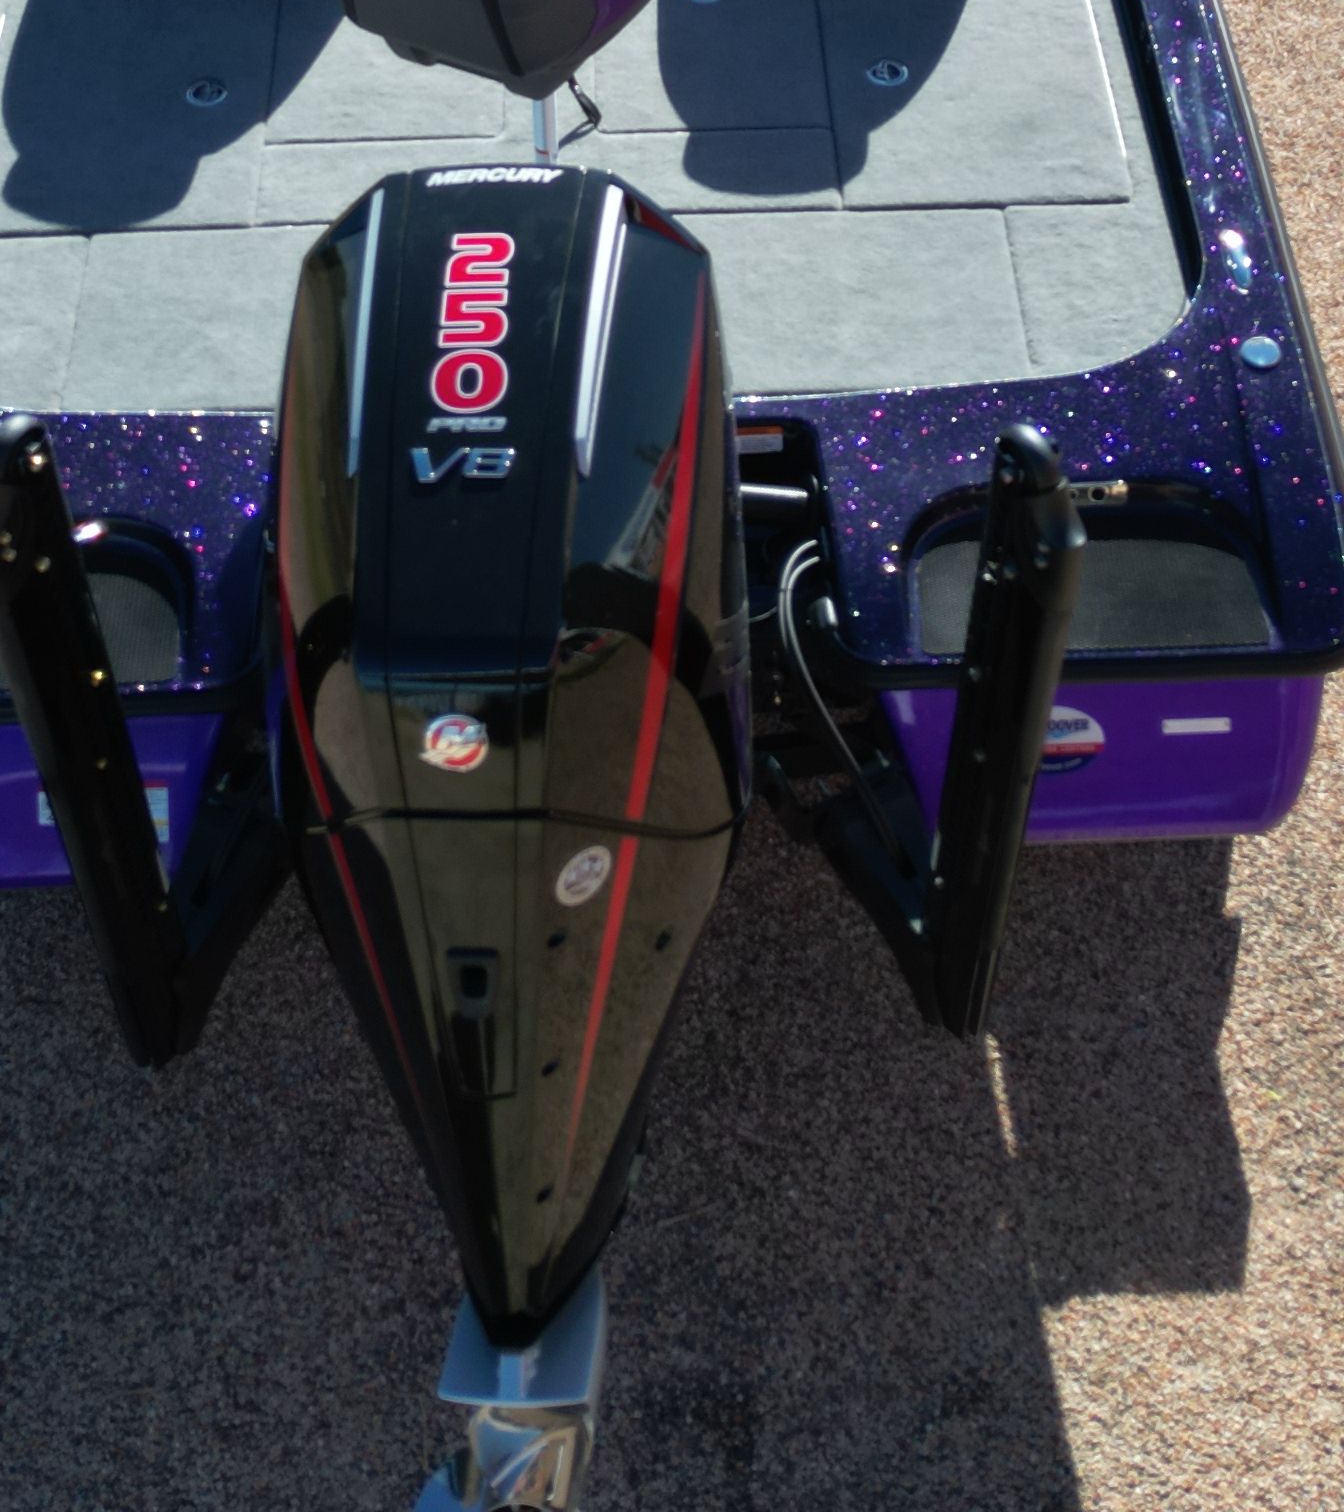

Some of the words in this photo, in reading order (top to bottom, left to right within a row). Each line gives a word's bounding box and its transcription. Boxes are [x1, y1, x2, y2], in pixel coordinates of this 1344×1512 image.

[425, 167, 564, 187] MERCURY
[430, 232, 515, 414] 250
[426, 416, 507, 433] PRO
[410, 447, 516, 483] V8
